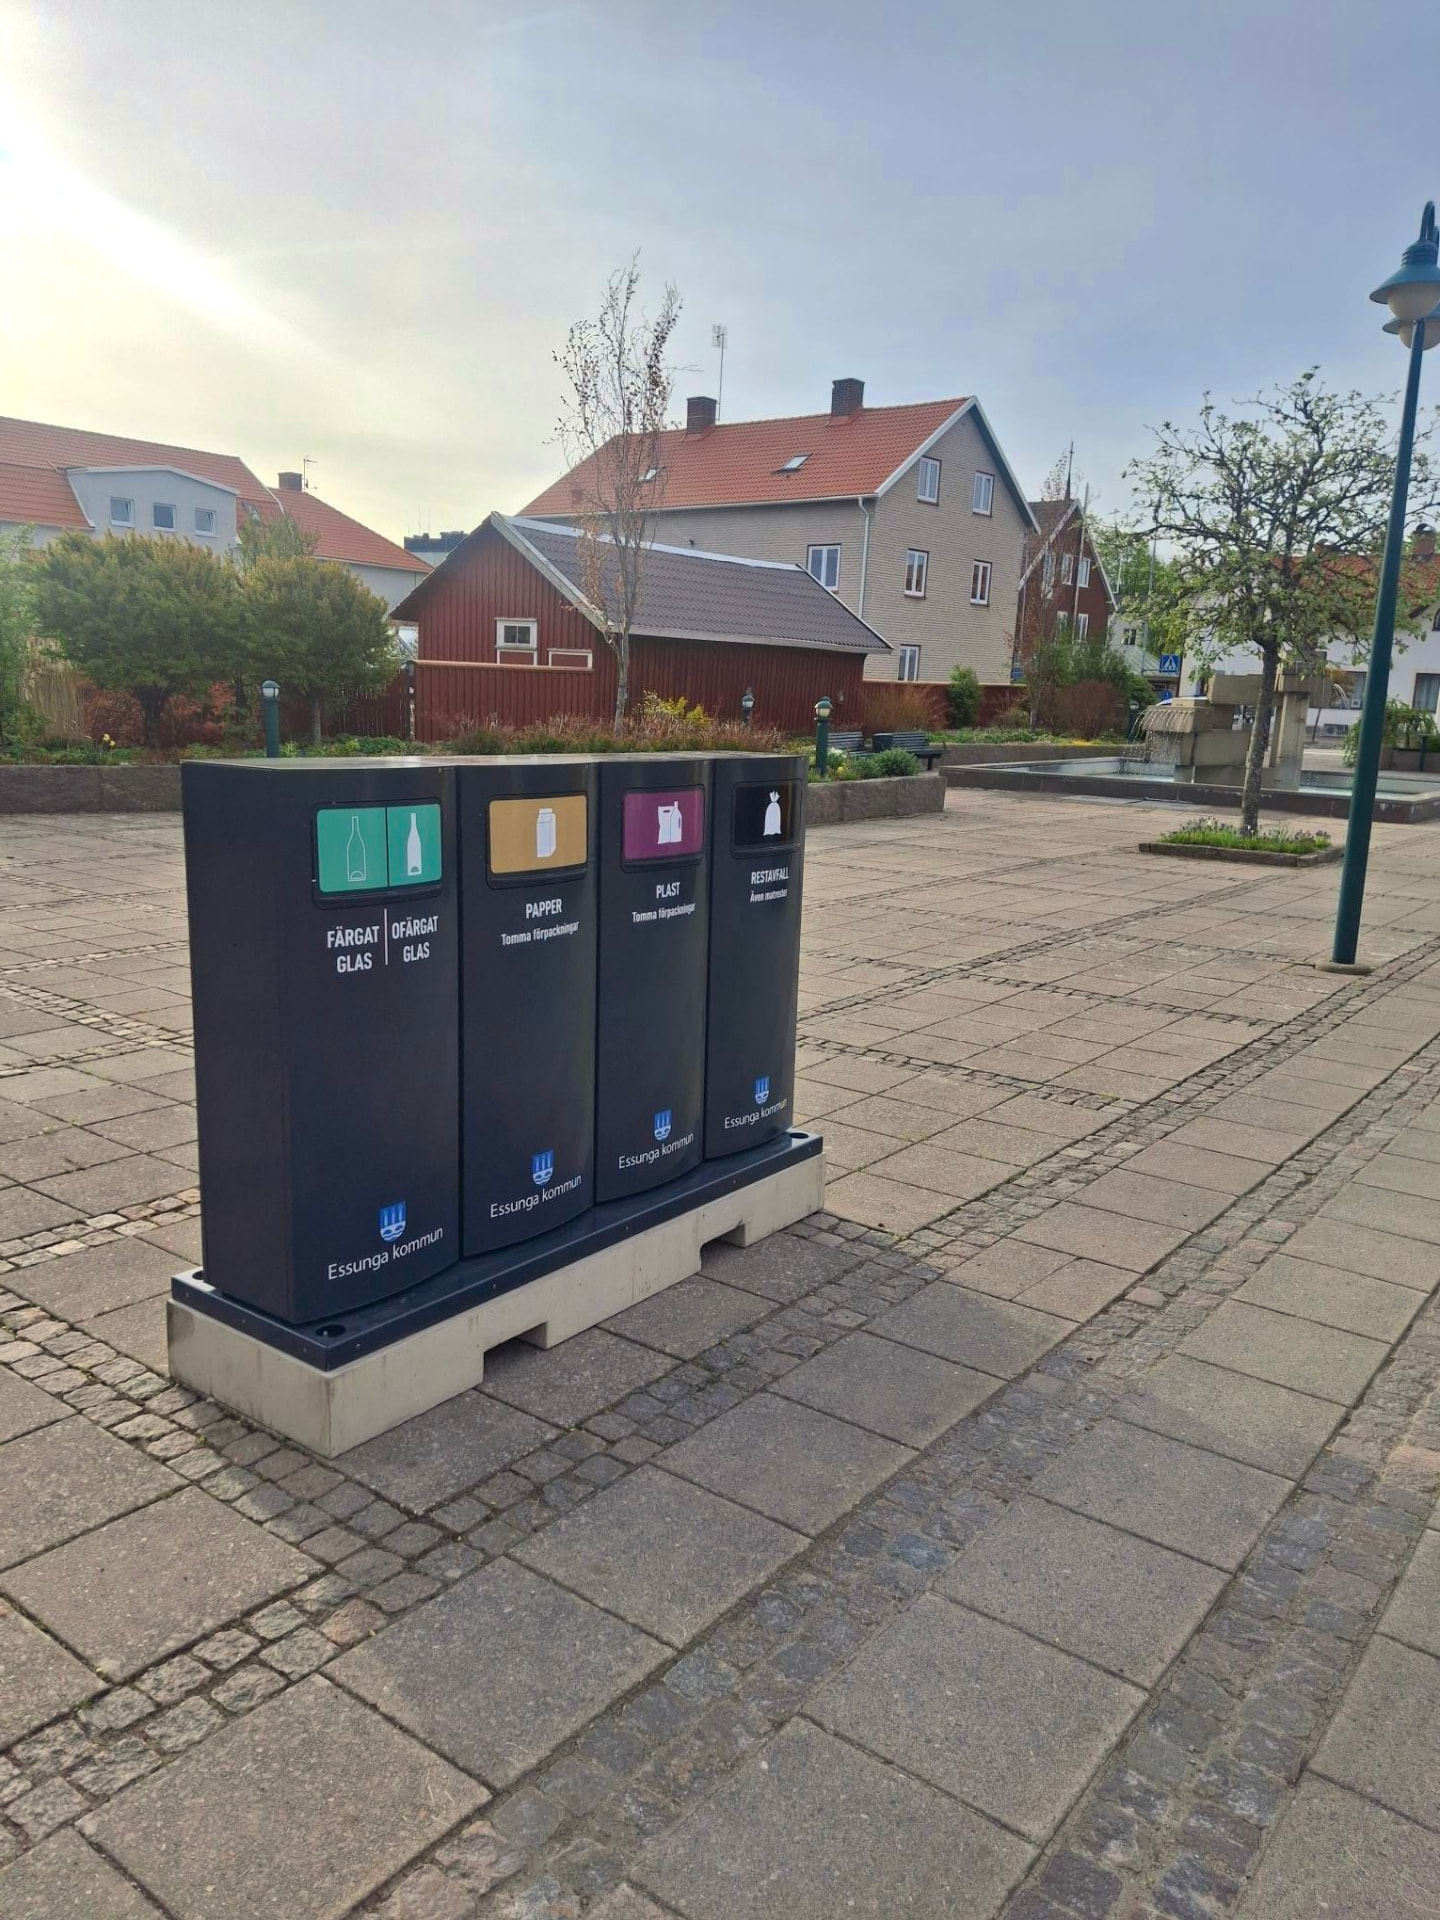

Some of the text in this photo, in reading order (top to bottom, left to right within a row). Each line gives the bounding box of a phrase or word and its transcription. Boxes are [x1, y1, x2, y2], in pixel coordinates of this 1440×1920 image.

[750, 867, 790, 885] RESTAVFALL
[656, 882, 681, 899] PLAST
[750, 890, 764, 903] Även
[525, 898, 563, 919] PAPPER
[632, 902, 696, 924] Tomma förpackningar
[327, 925, 380, 949] FÄRGAT
[391, 915, 439, 939] OFÄRGAT
[501, 920, 580, 946] Tomma förpackningar
[336, 952, 373, 973] GLAS
[403, 942, 430, 962] GLAS
[724, 1098, 787, 1129] Essunga kommun
[618, 1132, 694, 1169] Essunga kommun
[490, 1174, 582, 1218] Essunga kommun
[327, 1225, 444, 1280] Essunga kommun
